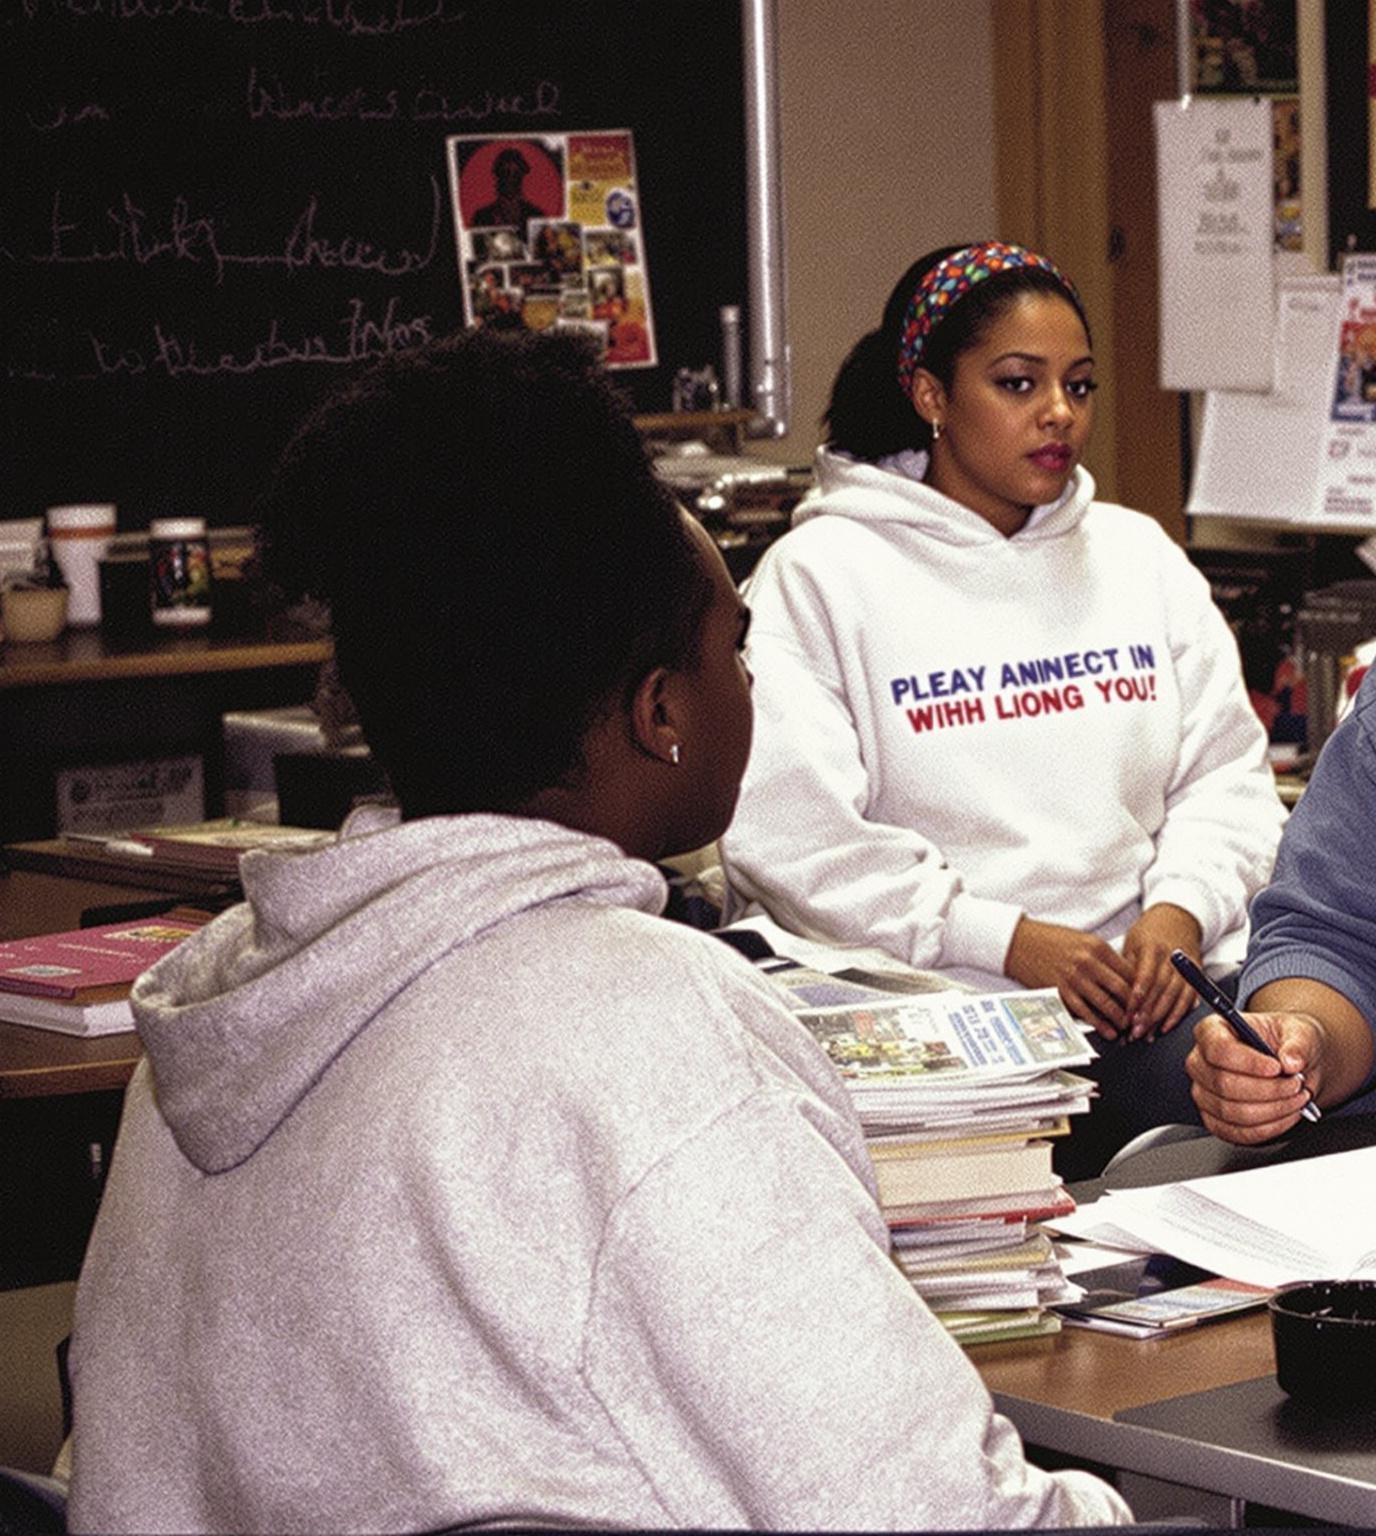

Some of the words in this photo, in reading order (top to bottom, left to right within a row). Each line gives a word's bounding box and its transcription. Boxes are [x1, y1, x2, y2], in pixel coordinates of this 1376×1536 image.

[890, 665, 986, 706] PLEAY
[1128, 644, 1156, 670] IN
[906, 697, 987, 734] WIHH
[994, 684, 1085, 720] LIONG
[1094, 674, 1157, 704] YOU!
